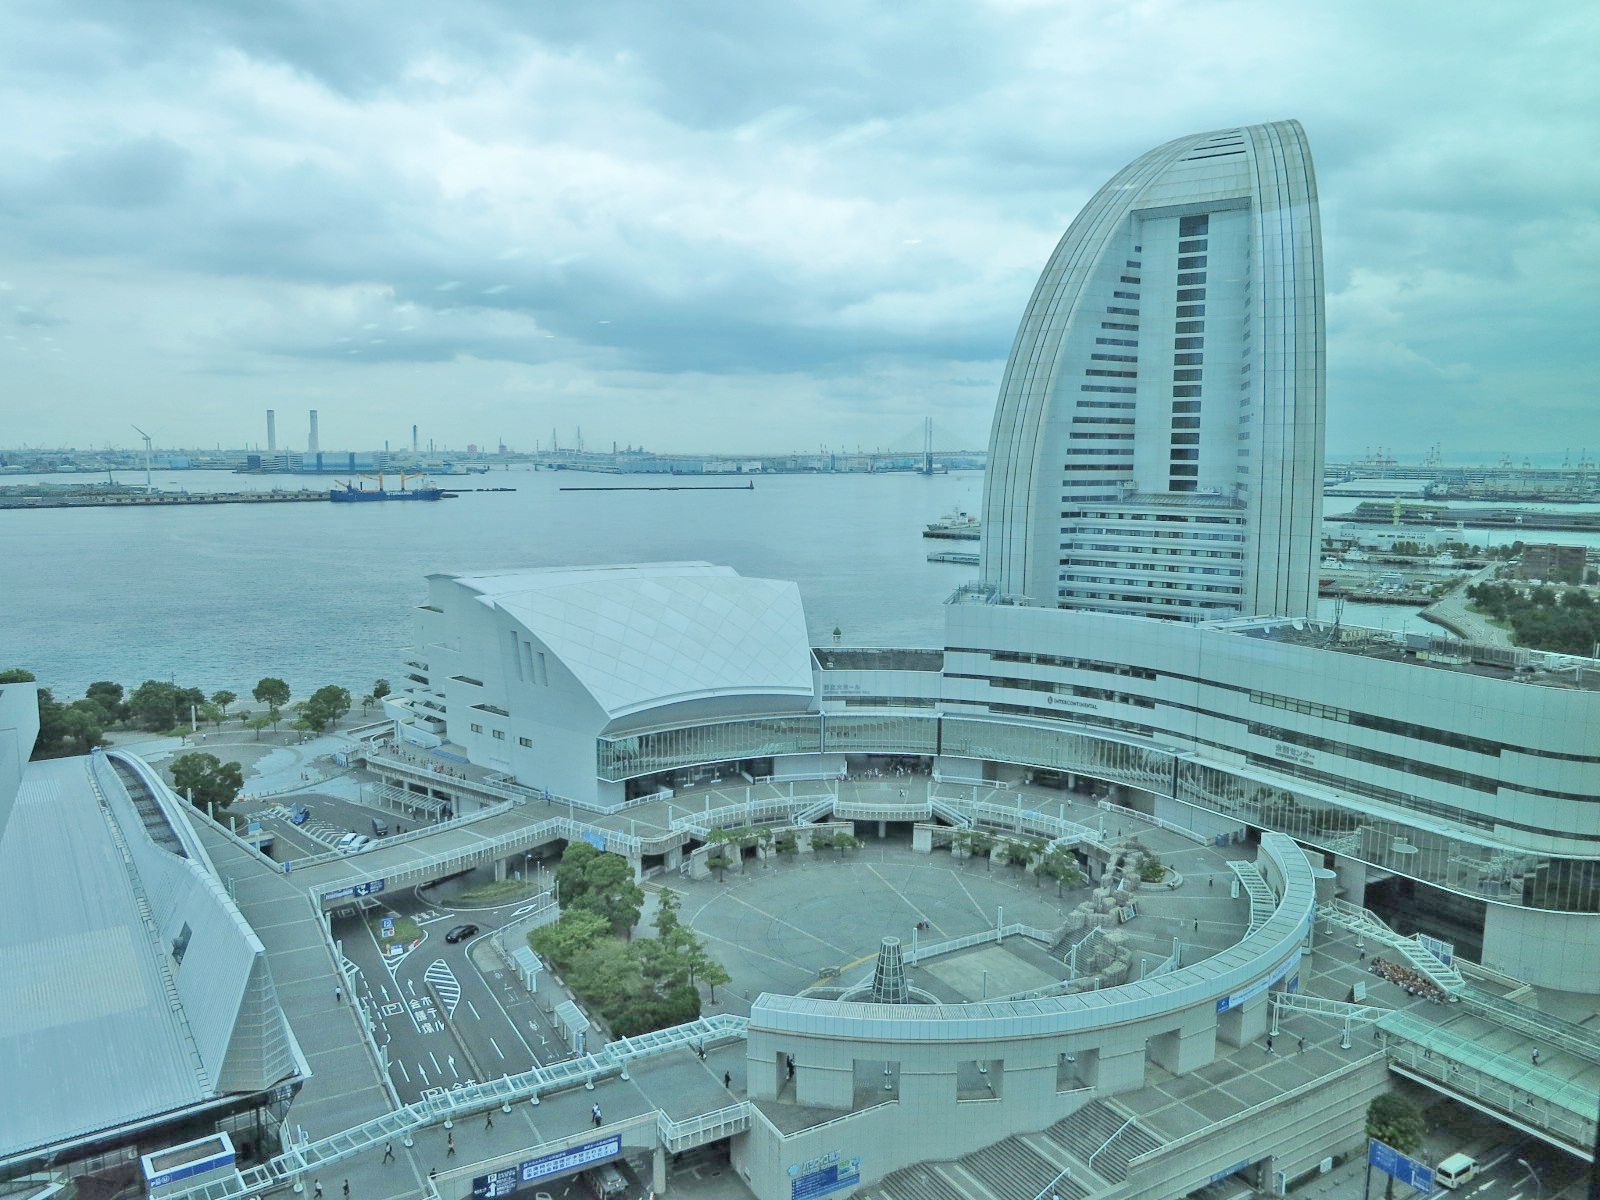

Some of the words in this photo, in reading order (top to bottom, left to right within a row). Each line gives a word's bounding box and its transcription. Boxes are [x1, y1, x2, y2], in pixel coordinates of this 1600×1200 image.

[1054, 697, 1098, 710] INTERCONTINENTAL
[421, 996, 445, 1032] ホテル
